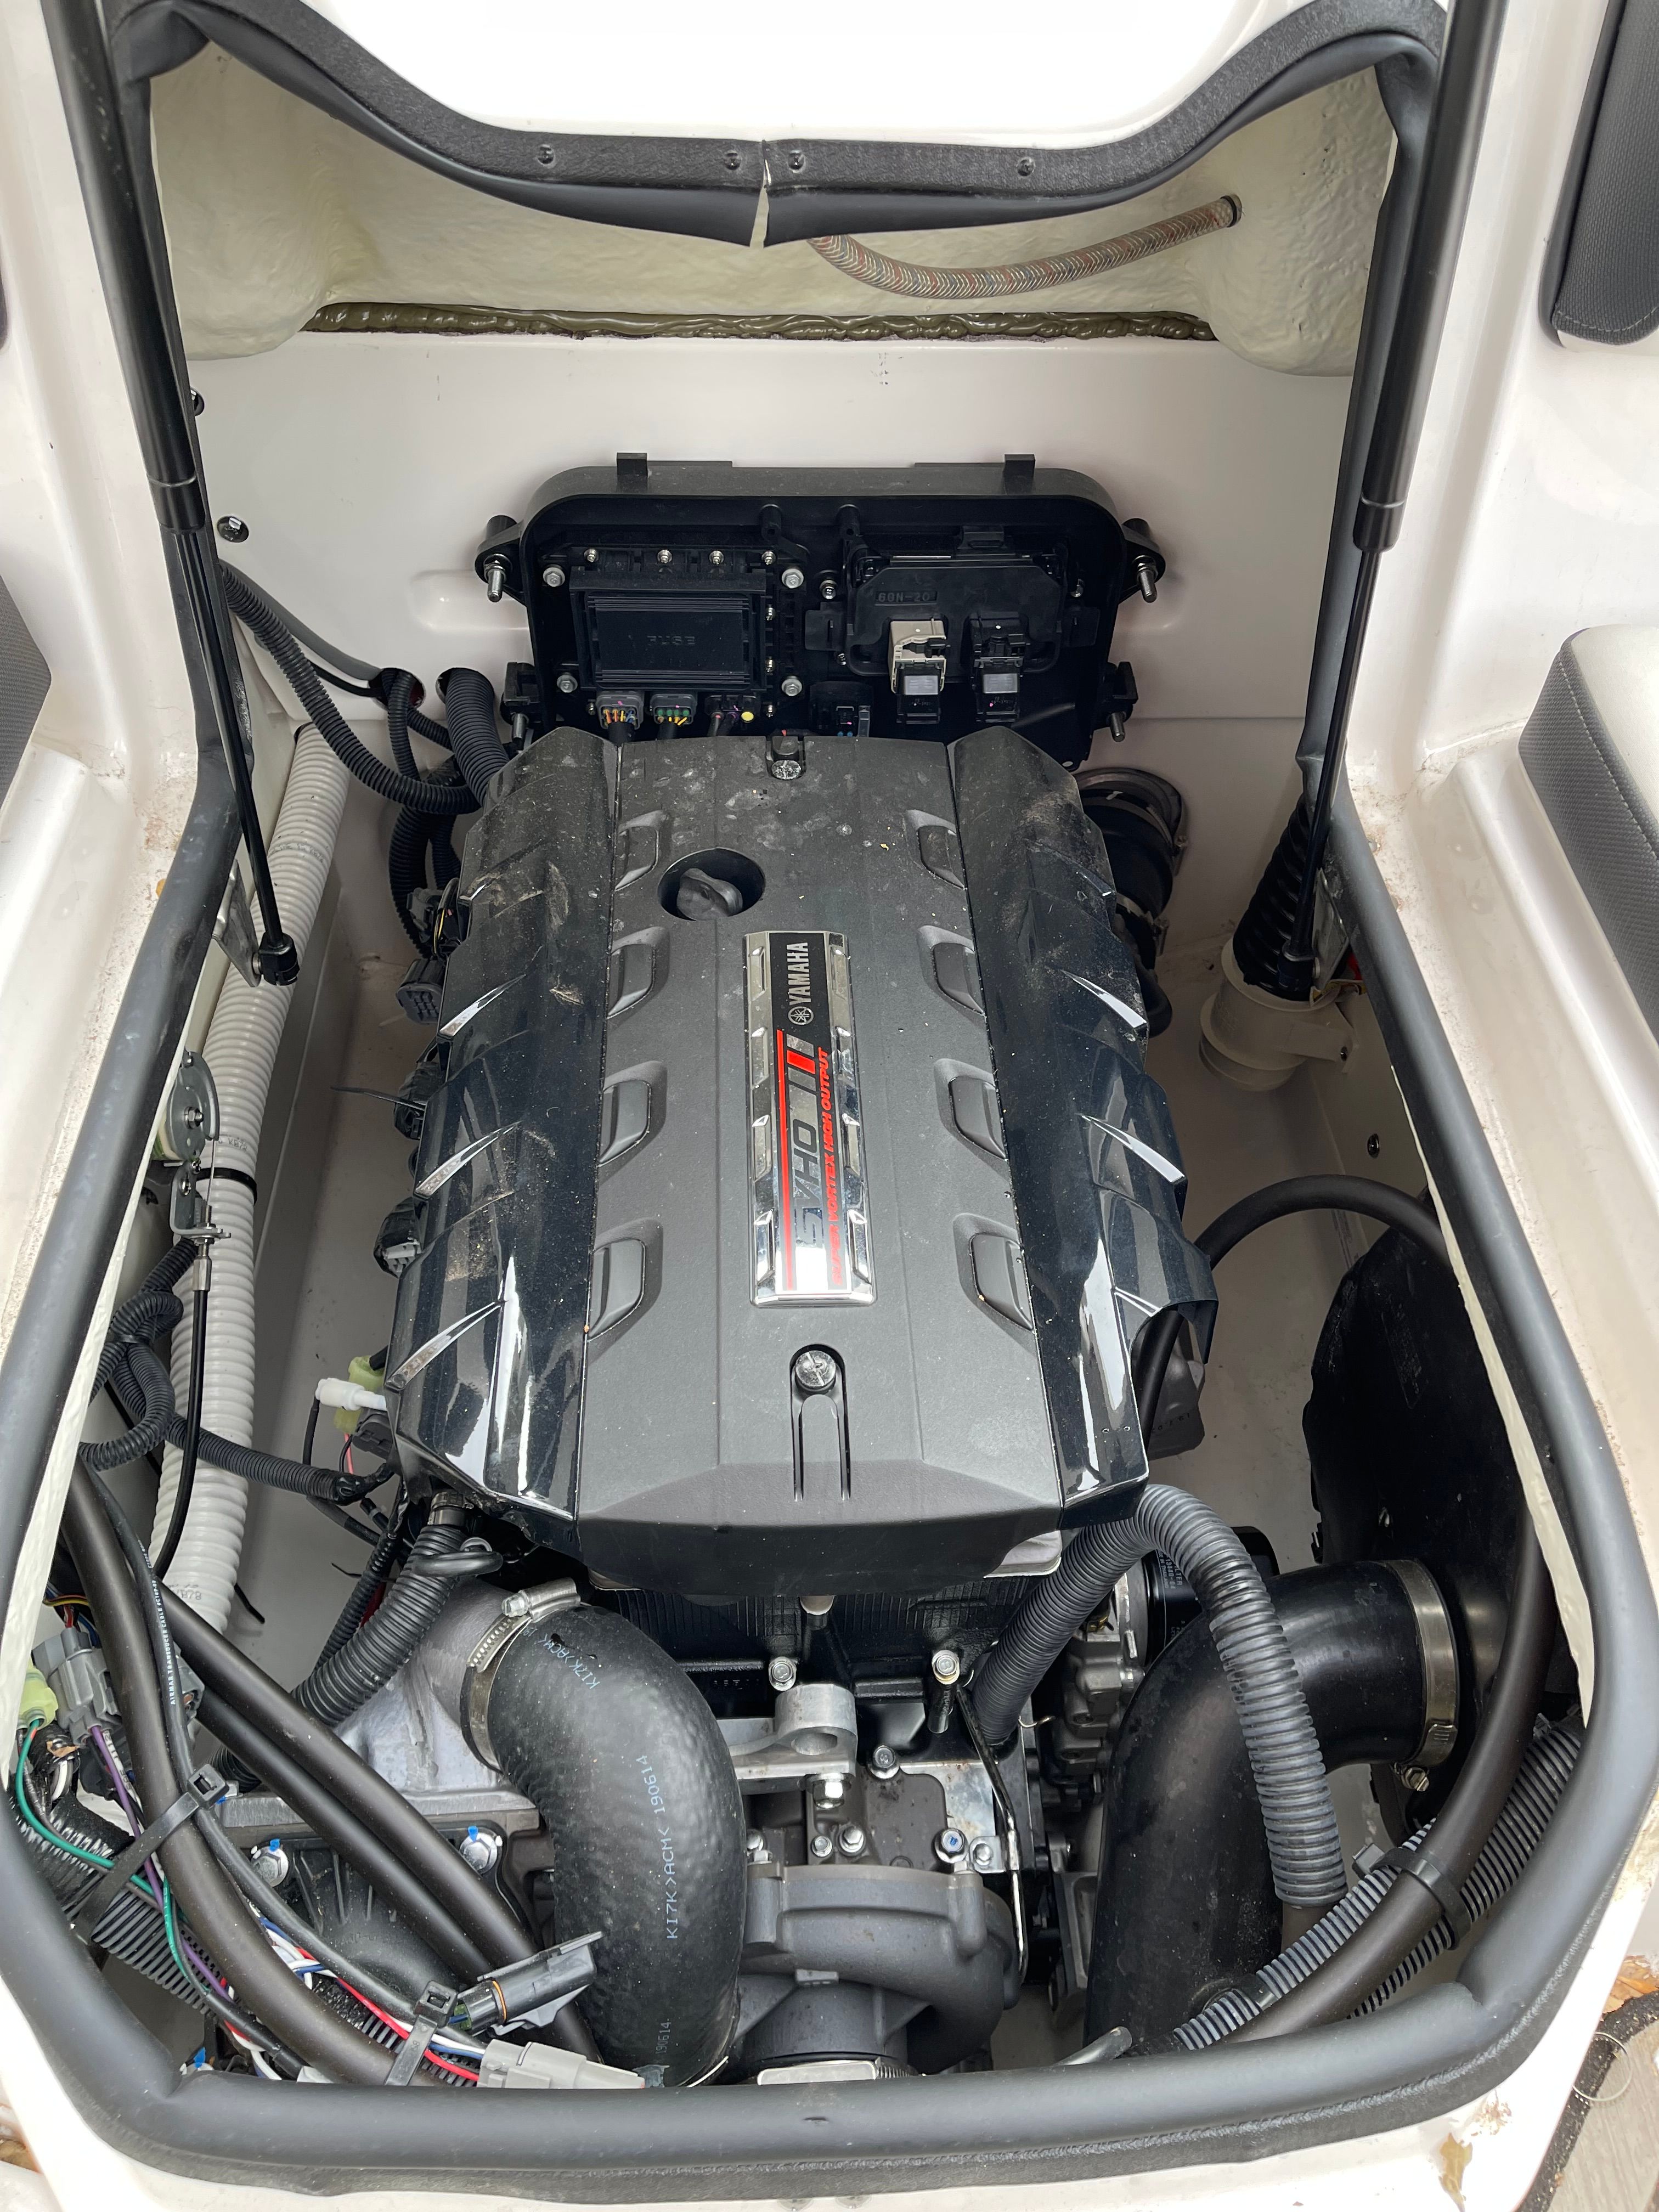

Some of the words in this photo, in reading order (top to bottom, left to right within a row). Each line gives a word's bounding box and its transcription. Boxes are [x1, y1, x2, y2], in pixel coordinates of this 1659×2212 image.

[787, 942, 811, 1006] YAMAHA
[817, 1046, 833, 1111] OUTPUT
[820, 1112, 835, 1152] HIGH
[793, 1119, 823, 1247] SVHO
[823, 1153, 839, 1222] VORTEX
[828, 1224, 843, 1285] SUPER
[157, 1608, 167, 1628] CABLE
[162, 1630, 173, 1674] TRANSDUCER
[635, 1754, 668, 1815] 190614
[655, 2021, 672, 2055] 190614
